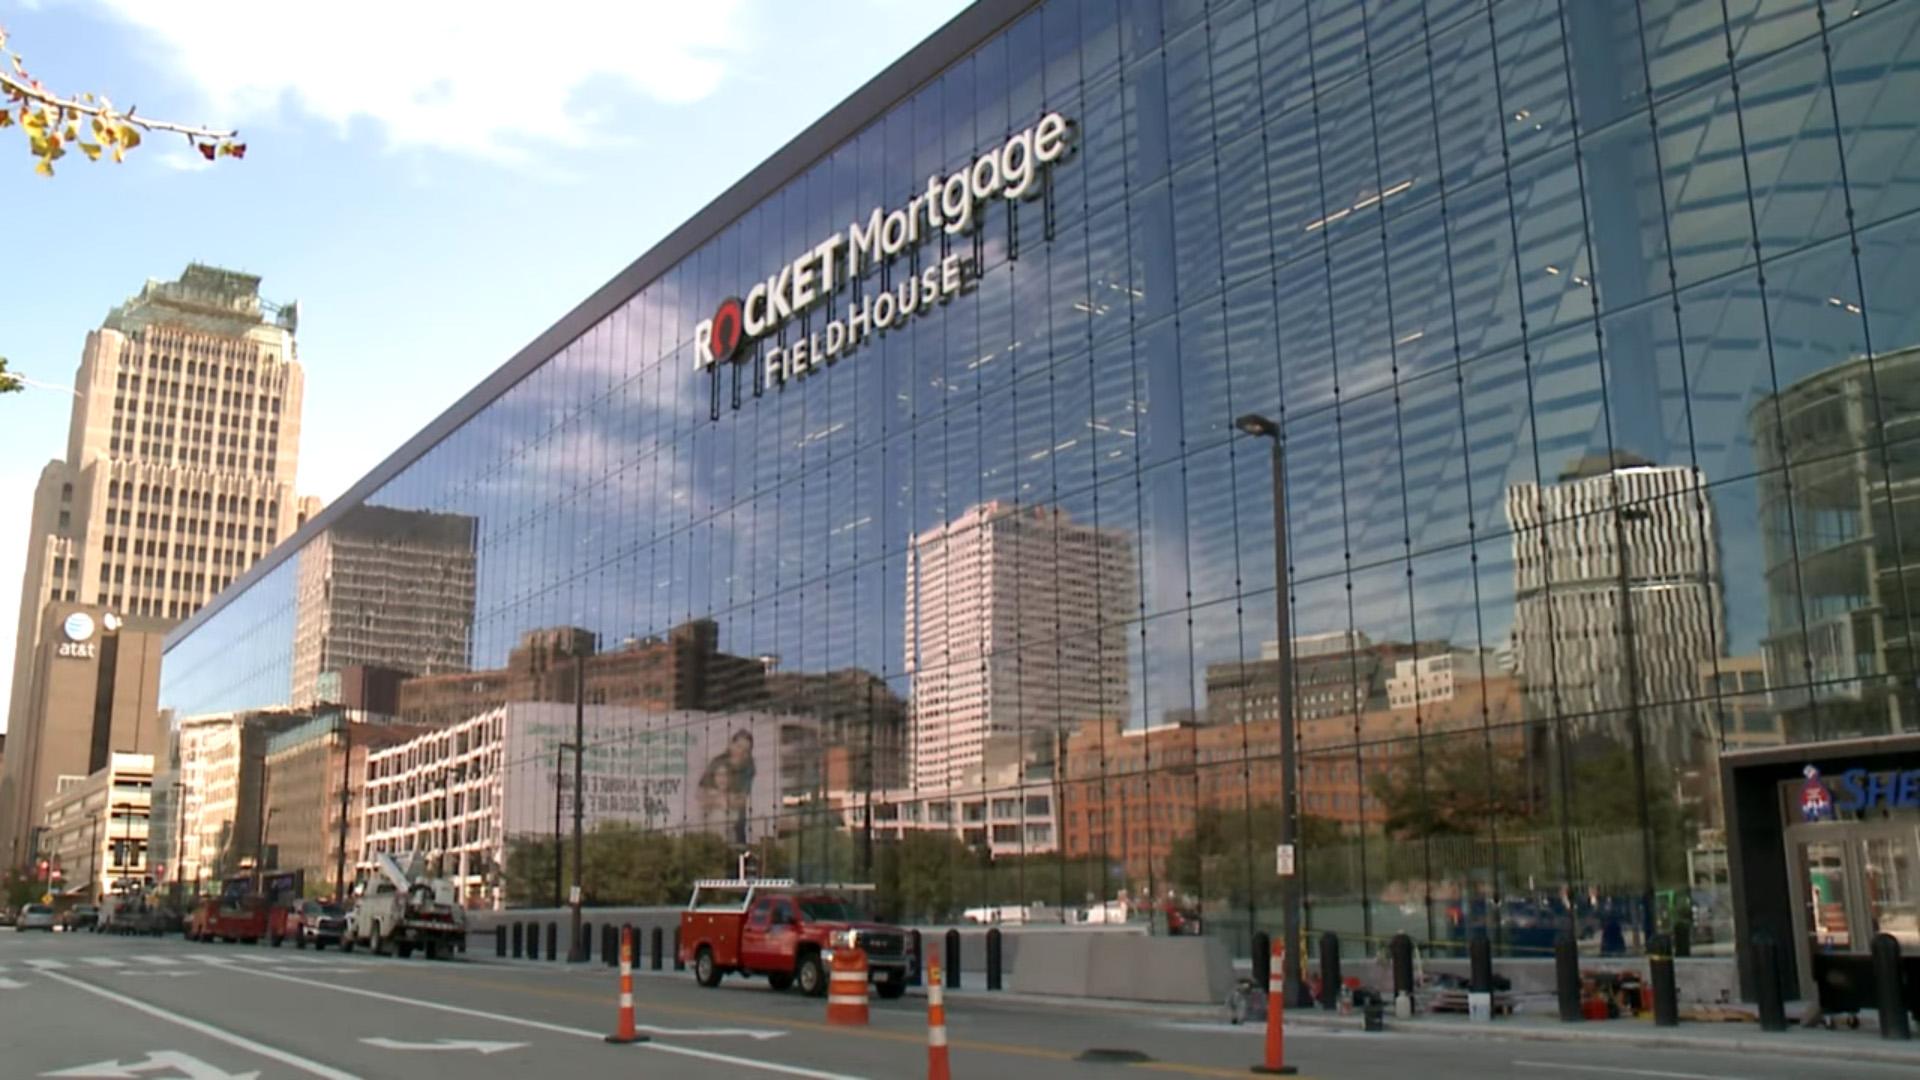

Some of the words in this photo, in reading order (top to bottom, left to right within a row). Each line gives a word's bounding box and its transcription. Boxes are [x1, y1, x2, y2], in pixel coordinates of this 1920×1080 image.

[694, 233, 843, 372] ROCKET
[849, 112, 1065, 278] Mortgage
[764, 253, 962, 389] FIELDHOUSE
[58, 642, 95, 658] at&t
